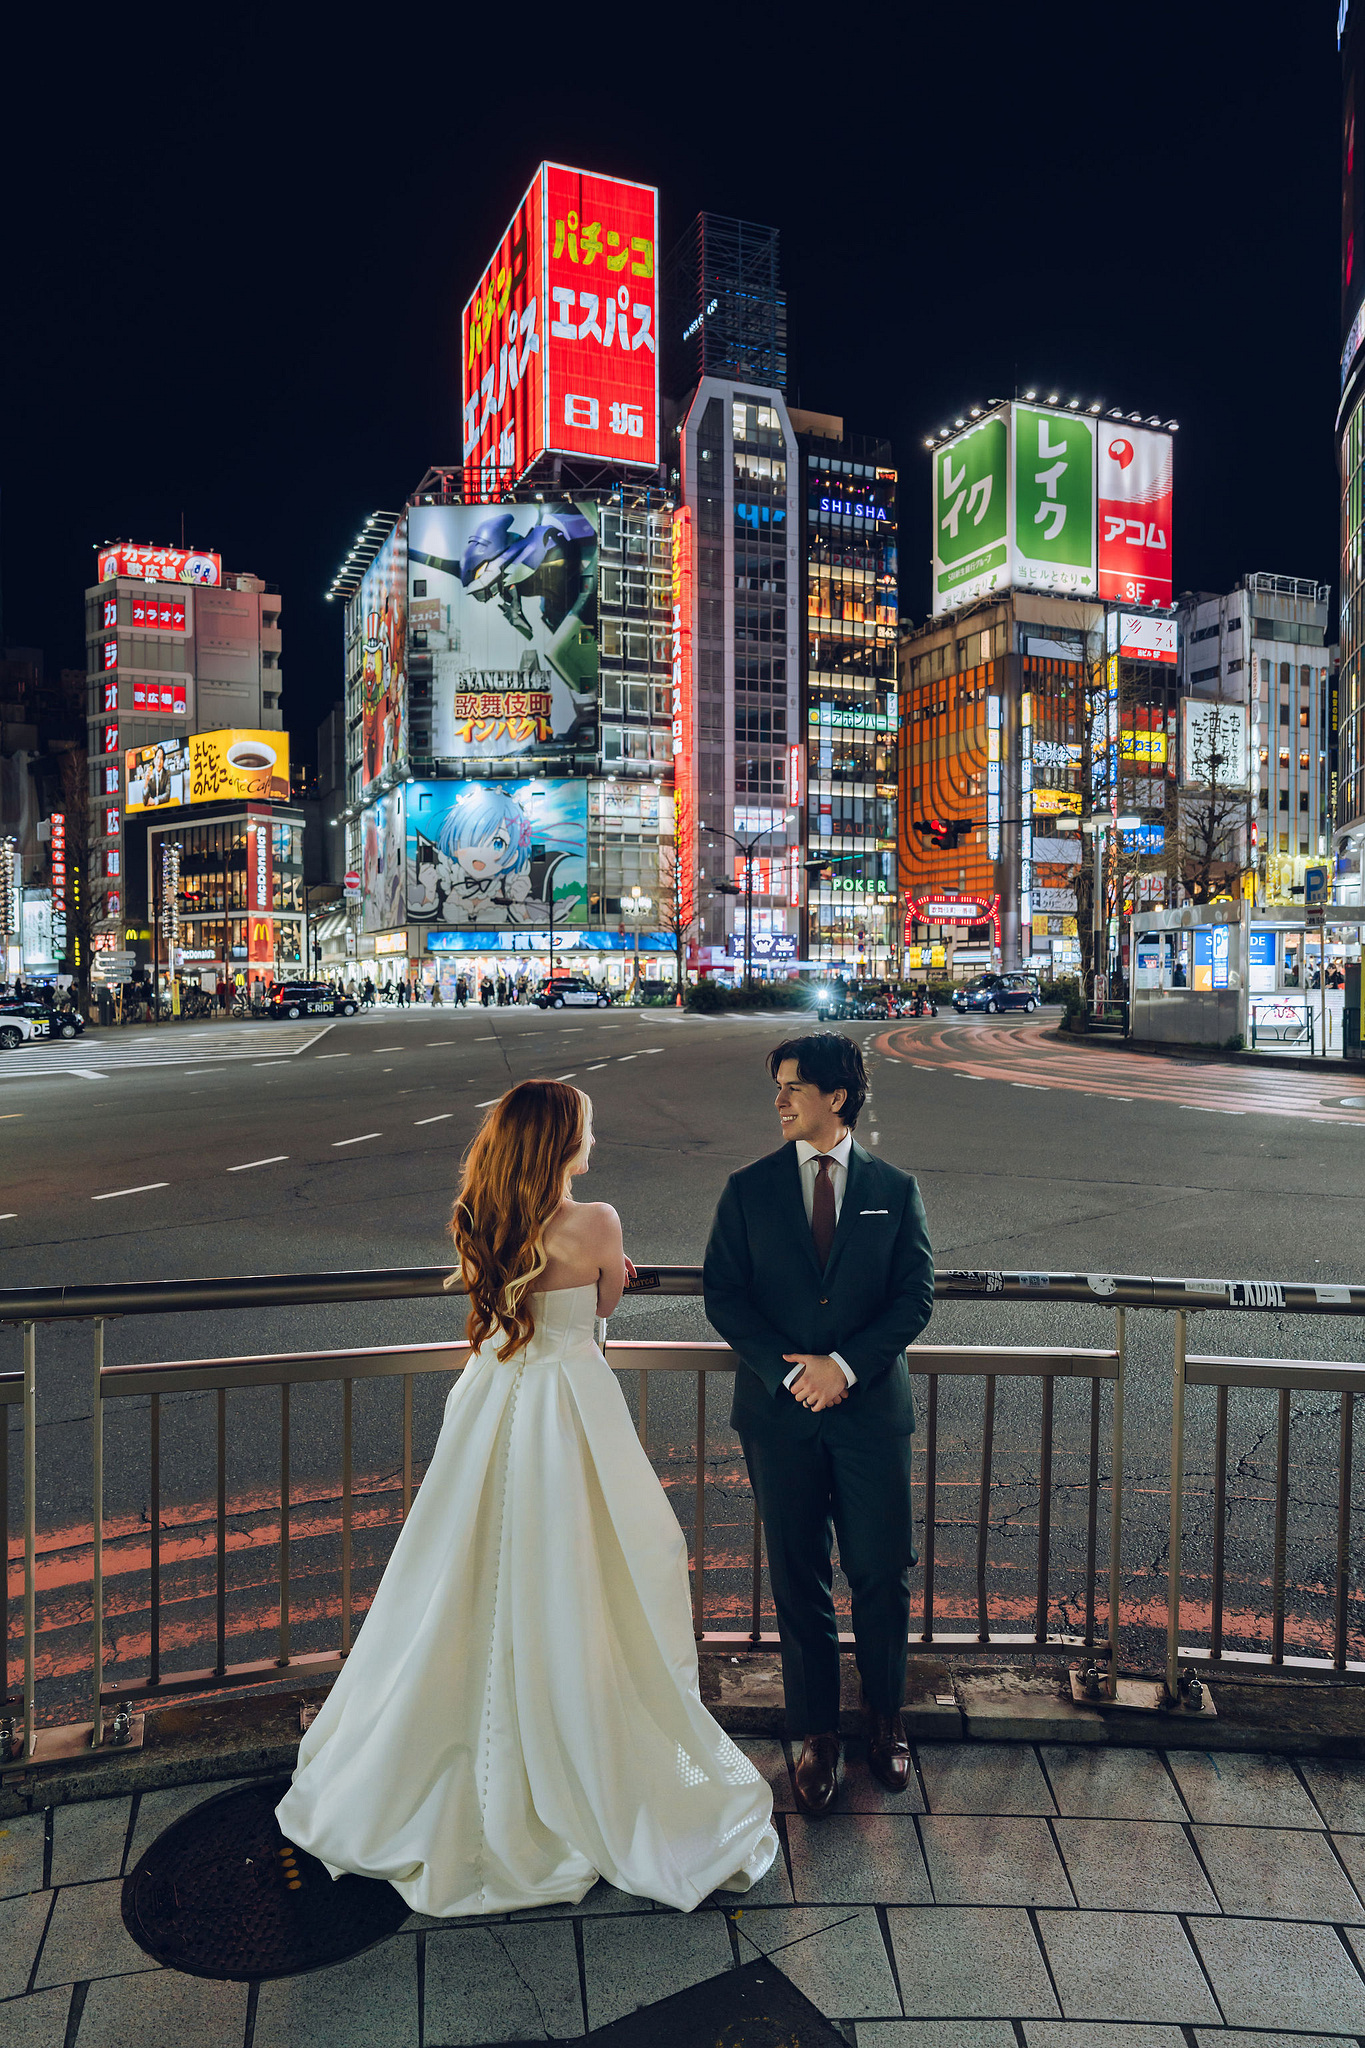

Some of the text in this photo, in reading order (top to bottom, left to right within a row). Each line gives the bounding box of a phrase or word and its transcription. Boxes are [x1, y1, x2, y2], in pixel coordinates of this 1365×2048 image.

[553, 211, 653, 278] パチンコ
[551, 285, 655, 353] エスパス
[463, 296, 540, 461] エスパス
[1034, 419, 1069, 540] レイク
[941, 455, 993, 539] レイク
[821, 499, 886, 520] SHISHA
[1104, 515, 1167, 550] アコム
[122, 546, 185, 566] カラオケ
[833, 554, 885, 571] POKER
[126, 562, 176, 579] 歌広場
[1018, 566, 1078, 584] 当ビルとなり
[1126, 581, 1146, 599] 3F
[133, 607, 185, 624] カラオケ
[455, 671, 552, 691] EVANGELION
[455, 693, 552, 717] 歌舞伎町
[454, 717, 554, 743] インパクト
[1123, 738, 1163, 753] プロミス
[256, 825, 267, 907] McDonald's
[832, 878, 887, 893] POKER
[307, 1002, 335, 1014] S.RIDE
